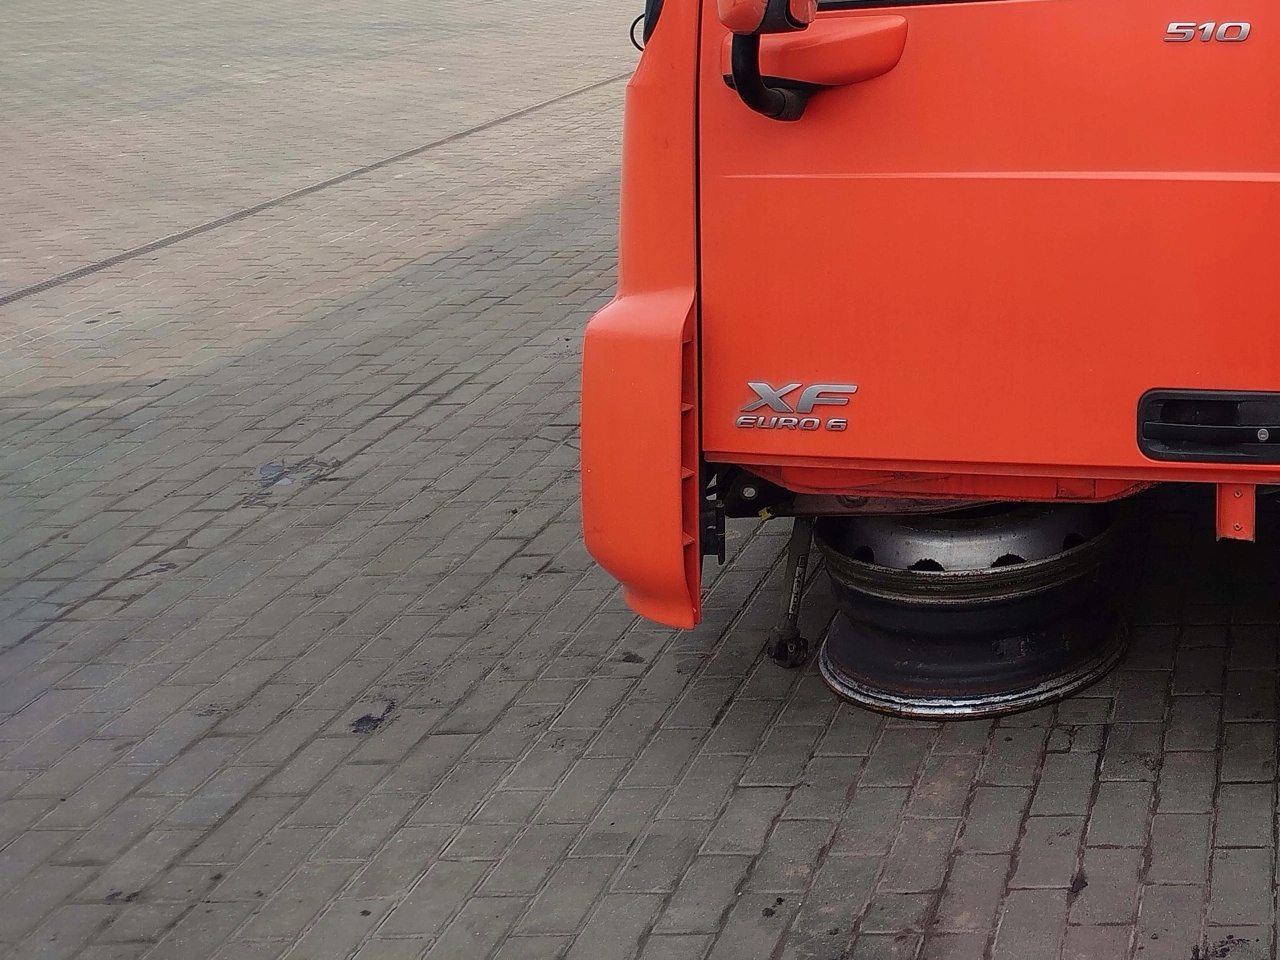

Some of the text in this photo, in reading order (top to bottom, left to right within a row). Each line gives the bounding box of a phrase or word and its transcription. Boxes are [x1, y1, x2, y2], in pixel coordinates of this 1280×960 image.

[1163, 22, 1252, 42] 510
[739, 382, 858, 414] XF
[735, 415, 848, 432] EURO 6
